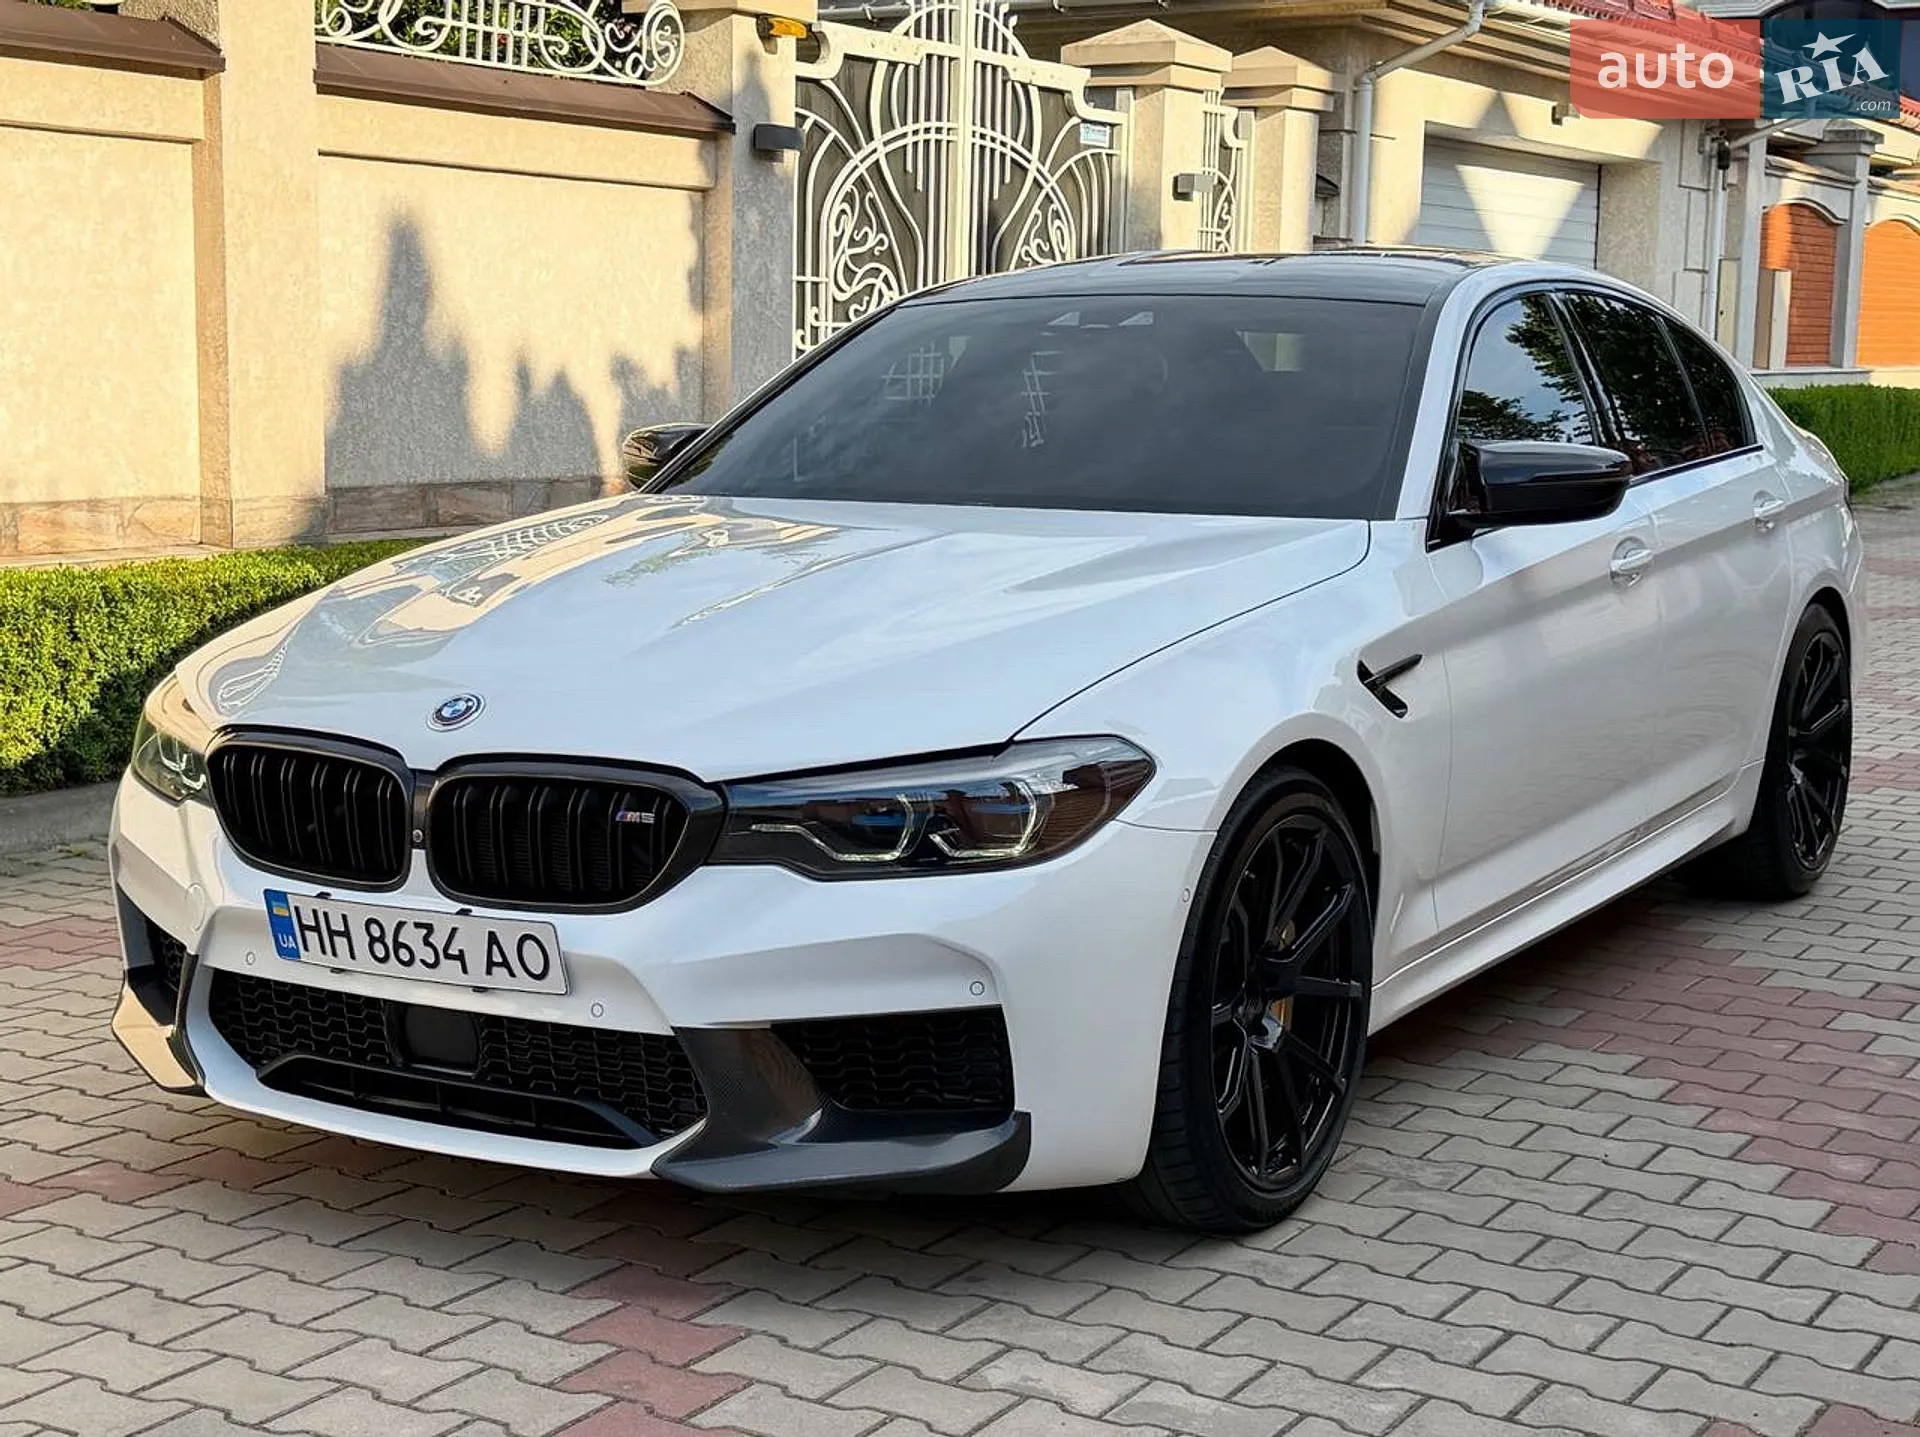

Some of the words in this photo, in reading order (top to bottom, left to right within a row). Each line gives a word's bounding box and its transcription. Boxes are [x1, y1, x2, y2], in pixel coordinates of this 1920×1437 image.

[278, 933, 297, 950] UA
[293, 905, 357, 961] HH
[364, 917, 469, 975] 8634
[485, 931, 551, 981] AO
